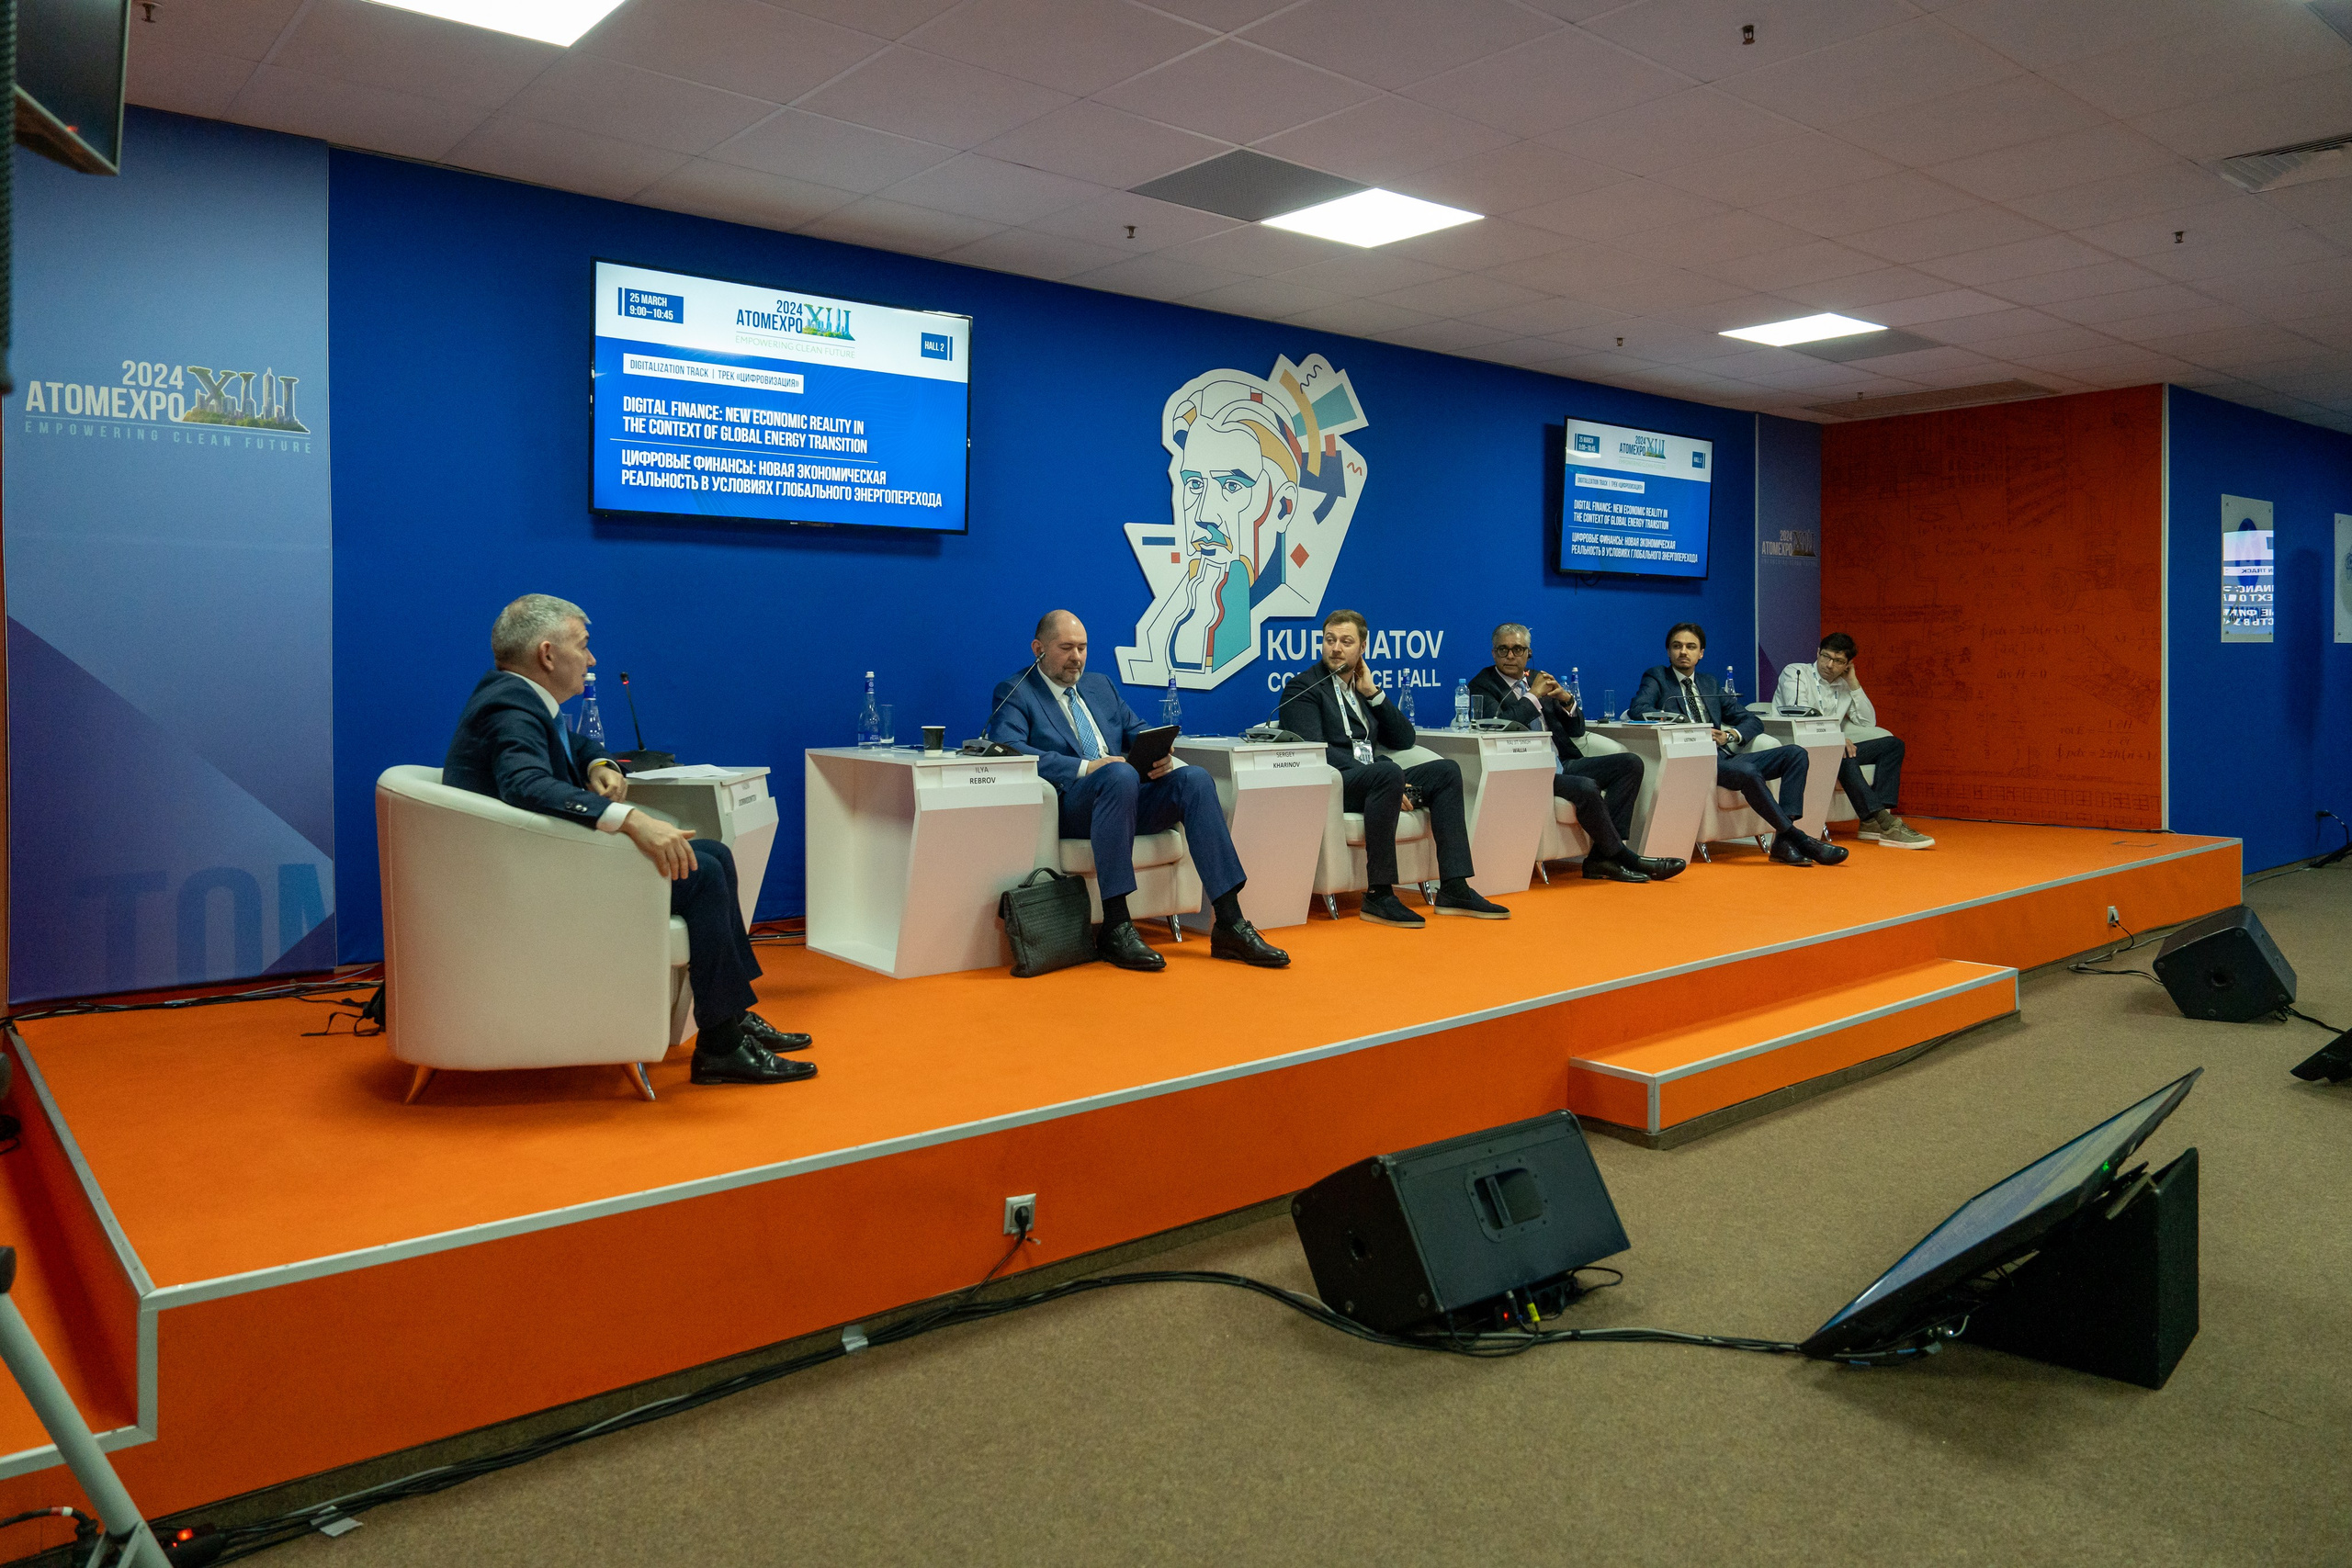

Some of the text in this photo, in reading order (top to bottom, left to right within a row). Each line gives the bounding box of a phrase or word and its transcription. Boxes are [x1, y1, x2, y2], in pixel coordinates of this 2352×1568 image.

[630, 293, 668, 307] 25 MARCH
[776, 299, 803, 316] 2024
[737, 309, 803, 333] ATOMEXPO
[736, 335, 855, 358] EMPOWERING CLEAN FUTURE
[925, 341, 944, 352] HALL 2
[122, 360, 184, 390] 2024
[630, 360, 799, 388] DIGITALIZATION TRACK ТРЕК «ЦИФРОВИЗАЦИЯ»
[26, 381, 185, 423] ATOMEXPO
[624, 396, 865, 435] DIGITAL FINANCE: NEW ECONOMIC REALITY IN
[25, 421, 311, 455] EMPOWERING CLEAN FUTURE
[623, 416, 867, 454] THE CONTEXT OF GLOBAL ENERGY TRANSITION
[1635, 435, 1646, 445] 2024
[1619, 443, 1645, 456] ATOMEXPO
[622, 449, 887, 485] ЦИФРОВЫЕ ФИНАНСЫ: НОВАЯ ЭКОНОМИЧЕСКАЯ
[622, 469, 943, 508] РЕАЛЬНОСТЬ В УСЛОВИЯХ ГЛОБАЛЬНОГО ЭНЕРГОПЕРЕХОДА
[1574, 500, 1591, 511] DIGITAL
[1592, 502, 1612, 513] FINANCE:
[1613, 503, 1623, 513] NEW
[1623, 505, 1645, 515] ECONOMIC
[1646, 507, 1663, 518] REALITY
[1574, 512, 1669, 530] THE CONTEXT OF GLOBAL ENERGY TRANSITION
[1572, 533, 1599, 544] ЦИФРОВЫЕ
[1624, 537, 1639, 547] НОВАЯ
[1640, 538, 1676, 549] ЭКОНОМИЧЕСКАЯ
[1780, 530, 1792, 541] 2024
[1571, 545, 1600, 556] РЕАЛЬНОСТЬ
[1601, 547, 1605, 557] В
[1606, 548, 1630, 558] УСЛОВИЯХ
[1631, 549, 1661, 560] ГЛОБАЛЬНОГО
[1762, 541, 1792, 556] ATOMEXPO
